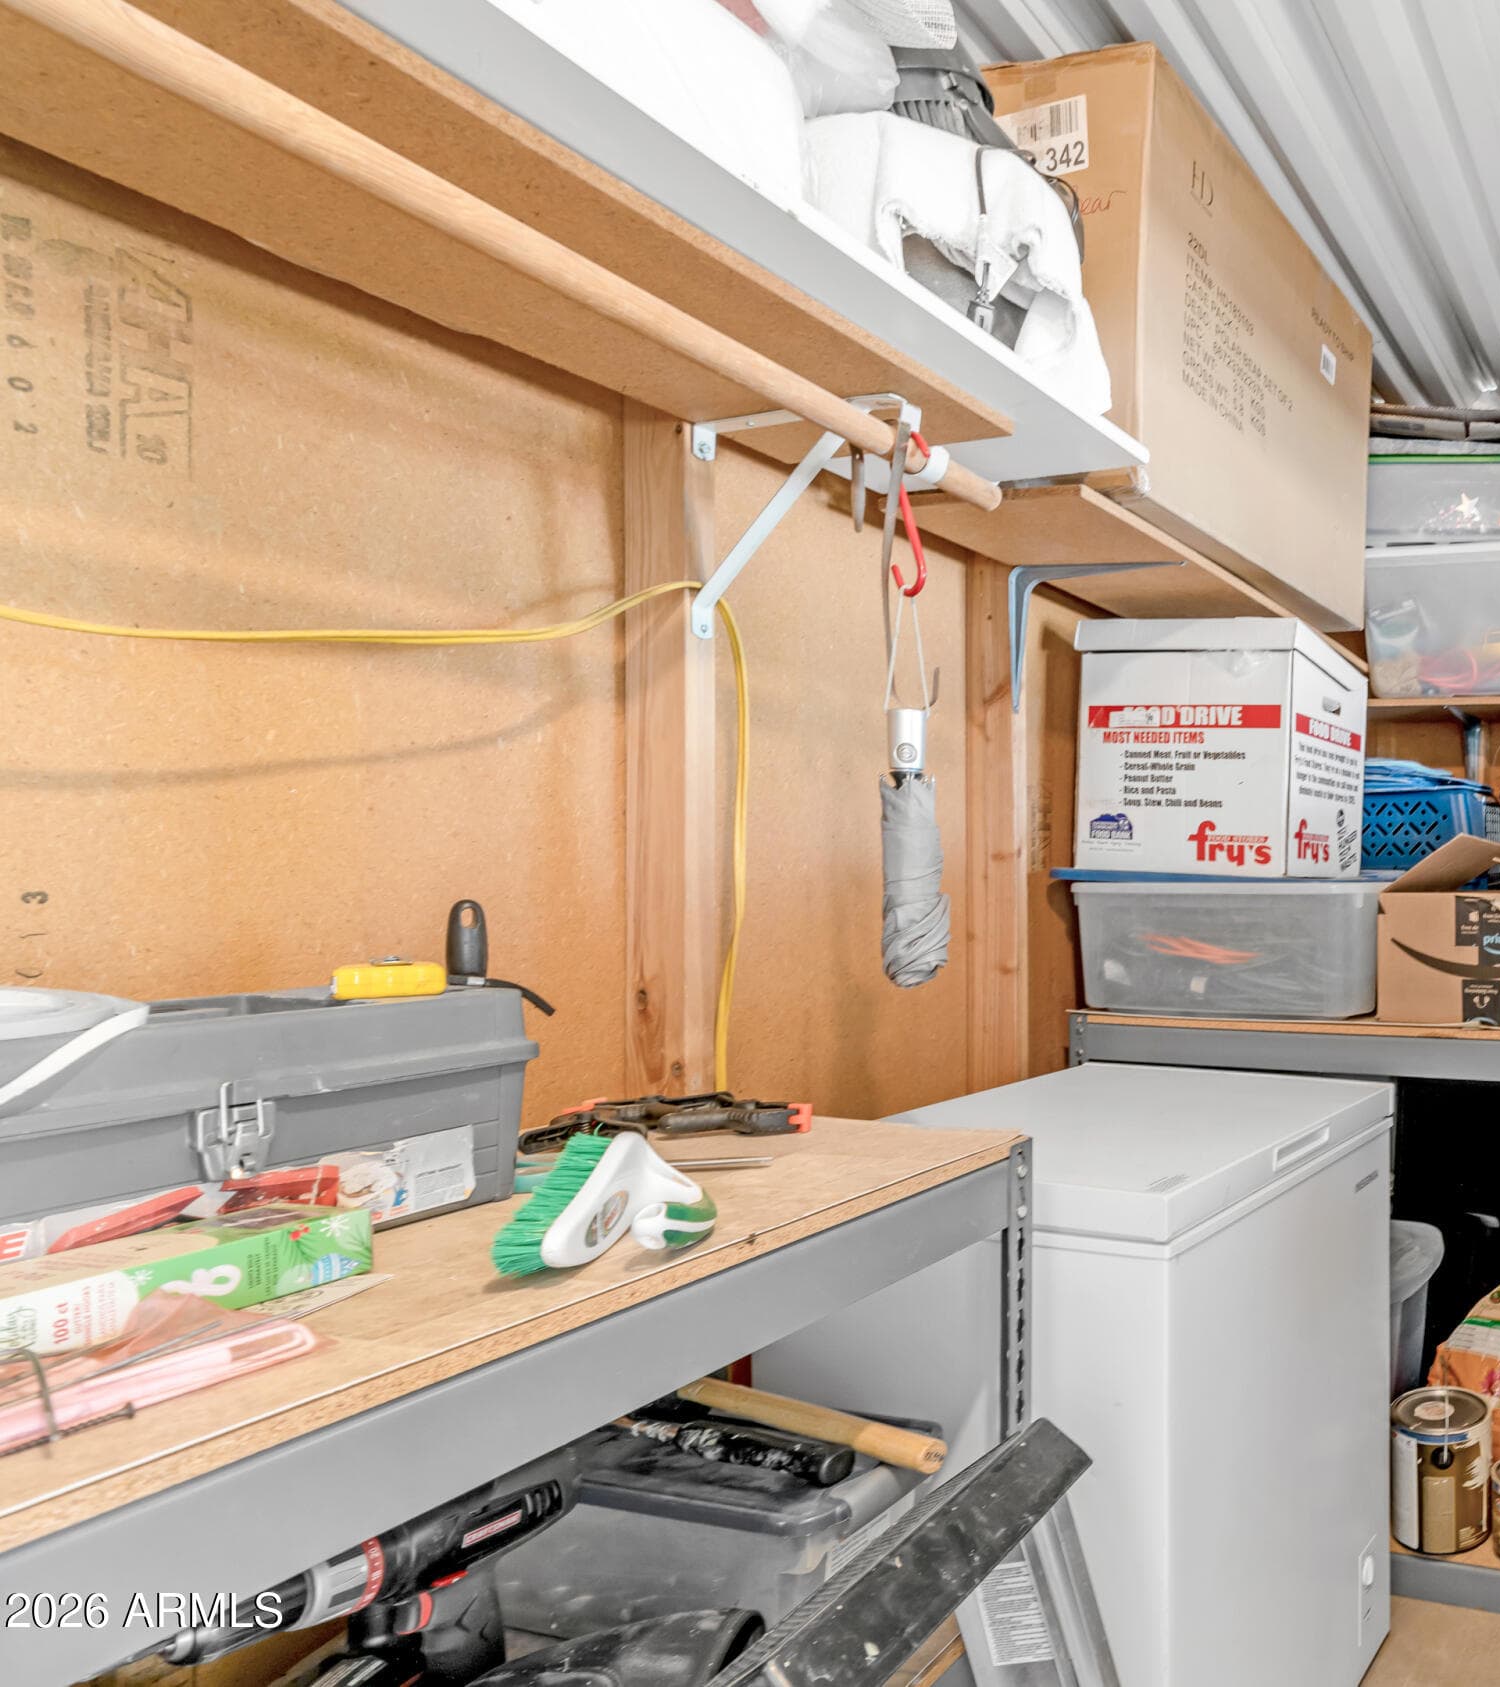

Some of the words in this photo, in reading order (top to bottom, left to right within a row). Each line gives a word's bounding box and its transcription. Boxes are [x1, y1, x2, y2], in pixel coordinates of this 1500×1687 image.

[1046, 141, 1085, 171] 342
[1074, 185, 1126, 215] ear
[1180, 706, 1243, 726] DRIVE
[1103, 731, 1131, 744] MOST
[1134, 731, 1170, 744] NEEDED
[1174, 731, 1205, 744] ITEMS
[1124, 750, 1151, 759] Canned
[1175, 750, 1193, 759] Fruit
[1203, 750, 1246, 761] Vegetables
[1175, 763, 1196, 771] Grain
[1123, 774, 1149, 783] Peanut
[1150, 774, 1173, 783] Butter
[1123, 786, 1139, 795] Rice
[1141, 786, 1154, 795] and
[1156, 786, 1176, 795] Pasta
[1184, 799, 1198, 808] and
[1188, 820, 1272, 867] fry's
[1294, 818, 1330, 864] fry's
[53, 1318, 70, 1344] 100
